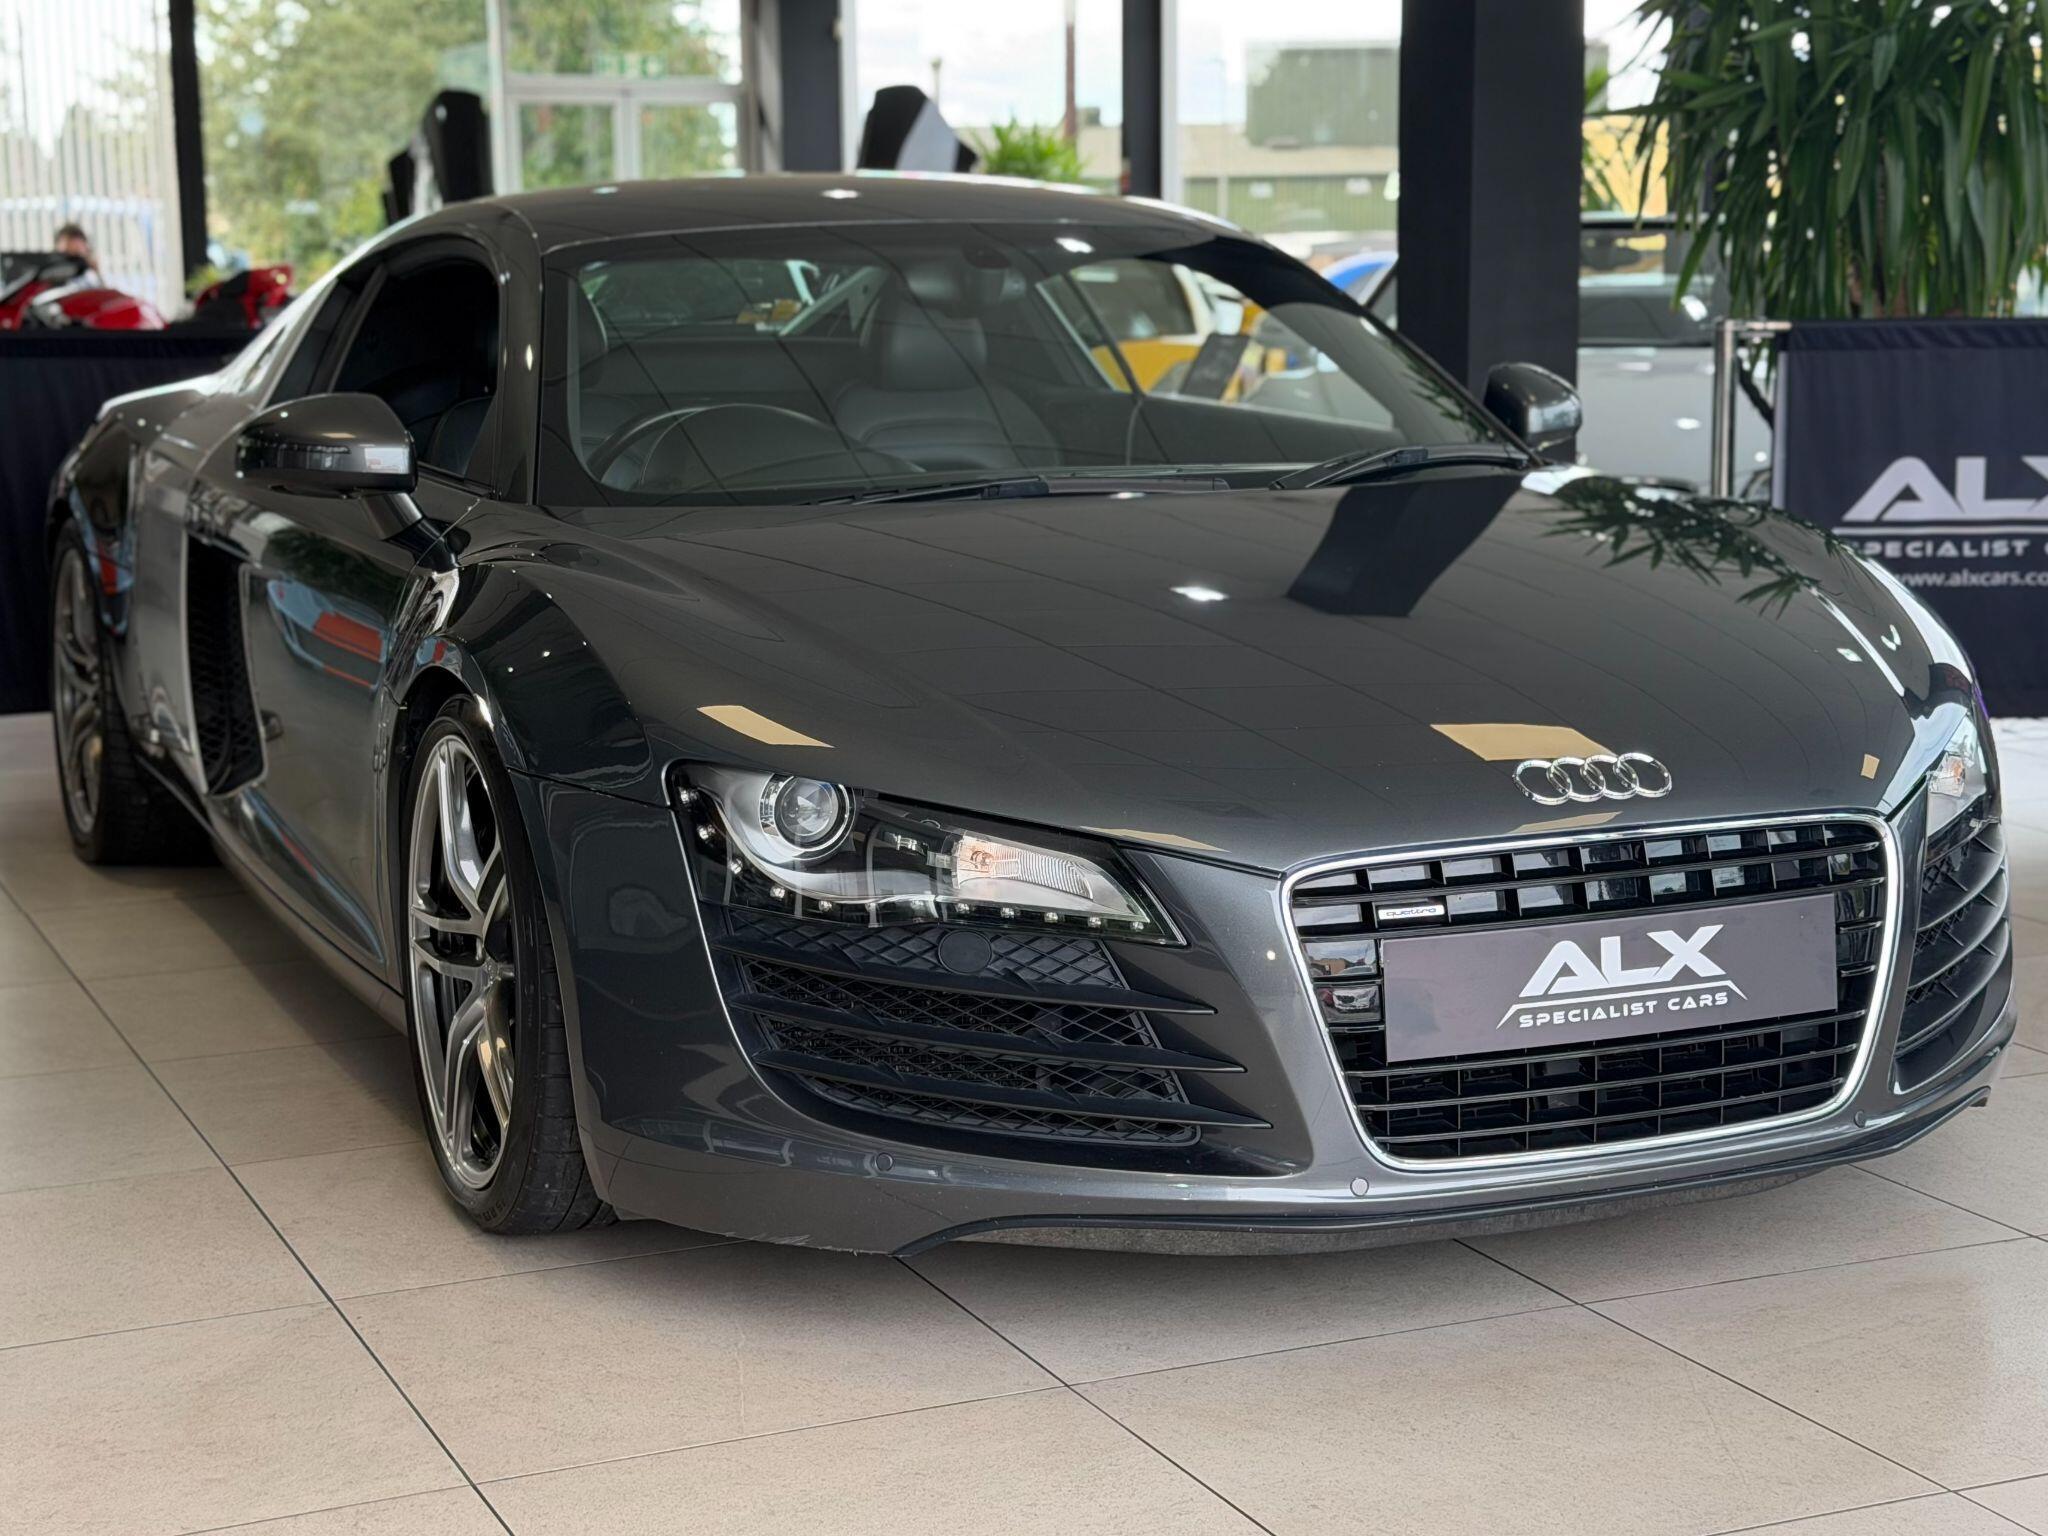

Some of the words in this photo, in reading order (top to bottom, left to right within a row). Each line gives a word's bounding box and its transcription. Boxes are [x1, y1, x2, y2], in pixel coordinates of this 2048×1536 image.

[1841, 456, 2048, 522] AL
[1854, 539, 2030, 558] PECIALIST
[1386, 907, 1437, 919] quattro
[1518, 924, 1727, 998] ALX
[1518, 1001, 1658, 1028] SPECIALIST
[1667, 992, 1729, 1011] CARS
